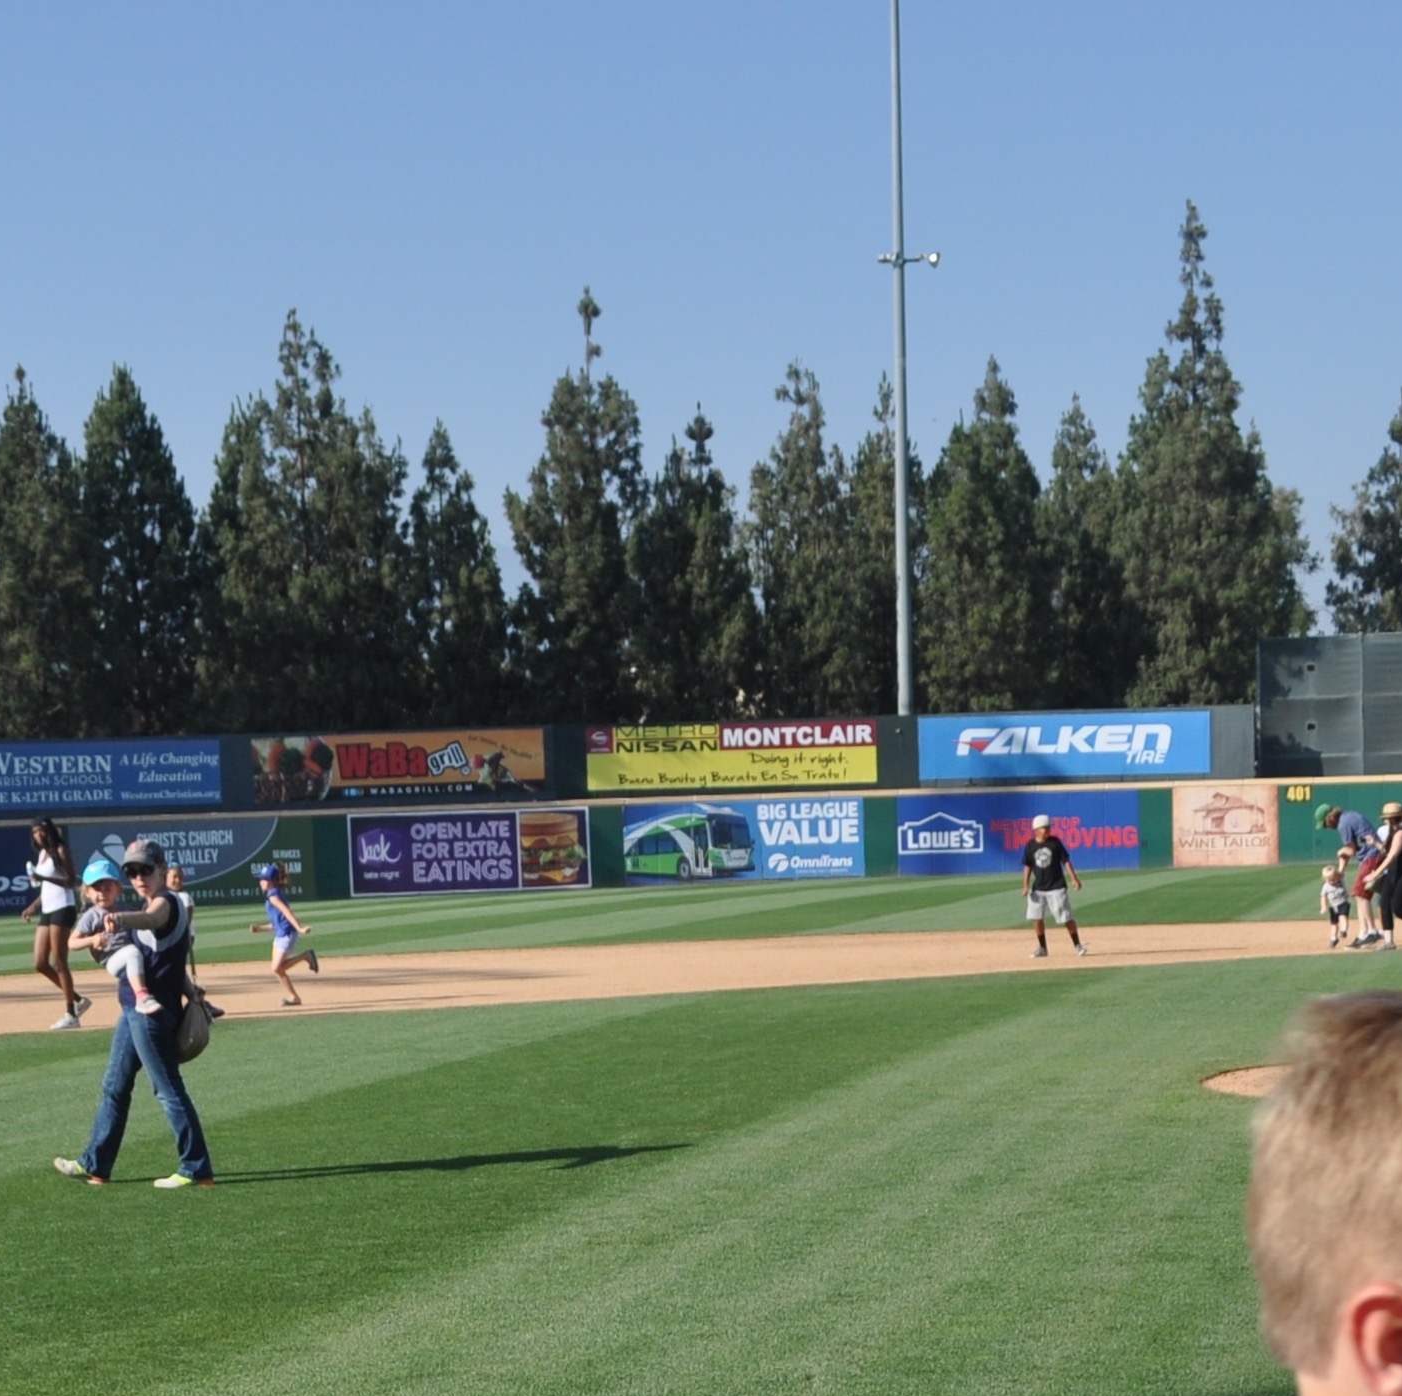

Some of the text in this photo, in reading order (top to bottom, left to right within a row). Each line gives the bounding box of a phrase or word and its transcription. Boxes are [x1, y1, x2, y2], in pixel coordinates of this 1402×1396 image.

[615, 724, 718, 738] METRO
[722, 724, 873, 748] MONTCLAIR
[615, 738, 718, 753] NISSAN
[956, 723, 1172, 757] FALKEN
[120, 752, 219, 768] A Life Changing
[336, 741, 429, 780] WaBa
[428, 742, 466, 774] grill
[750, 752, 848, 768] Doing it right.
[1126, 750, 1166, 765] TIRE
[54, 774, 113, 786] SCHOOLS
[138, 770, 202, 783] Education
[711, 771, 758, 783] Barato
[761, 771, 778, 782] En
[11, 790, 60, 803] K-12TH
[63, 789, 113, 802] GRADE
[120, 789, 221, 802] WesternChristian.org
[370, 784, 474, 794] WABAGRILL.COM
[1287, 786, 1311, 801] 401
[757, 801, 859, 820] BIG LEAGUE
[189, 829, 233, 846] CHURCH
[410, 820, 510, 840] OPEN LATE
[759, 818, 860, 846] VALUE
[358, 833, 401, 864] Jack
[412, 840, 512, 859] FOR EXTRA
[1179, 836, 1271, 848] WINE TAILOR
[178, 848, 219, 865] VALLEY
[790, 854, 854, 869] OmniTrans
[413, 859, 513, 883] EATINGS
